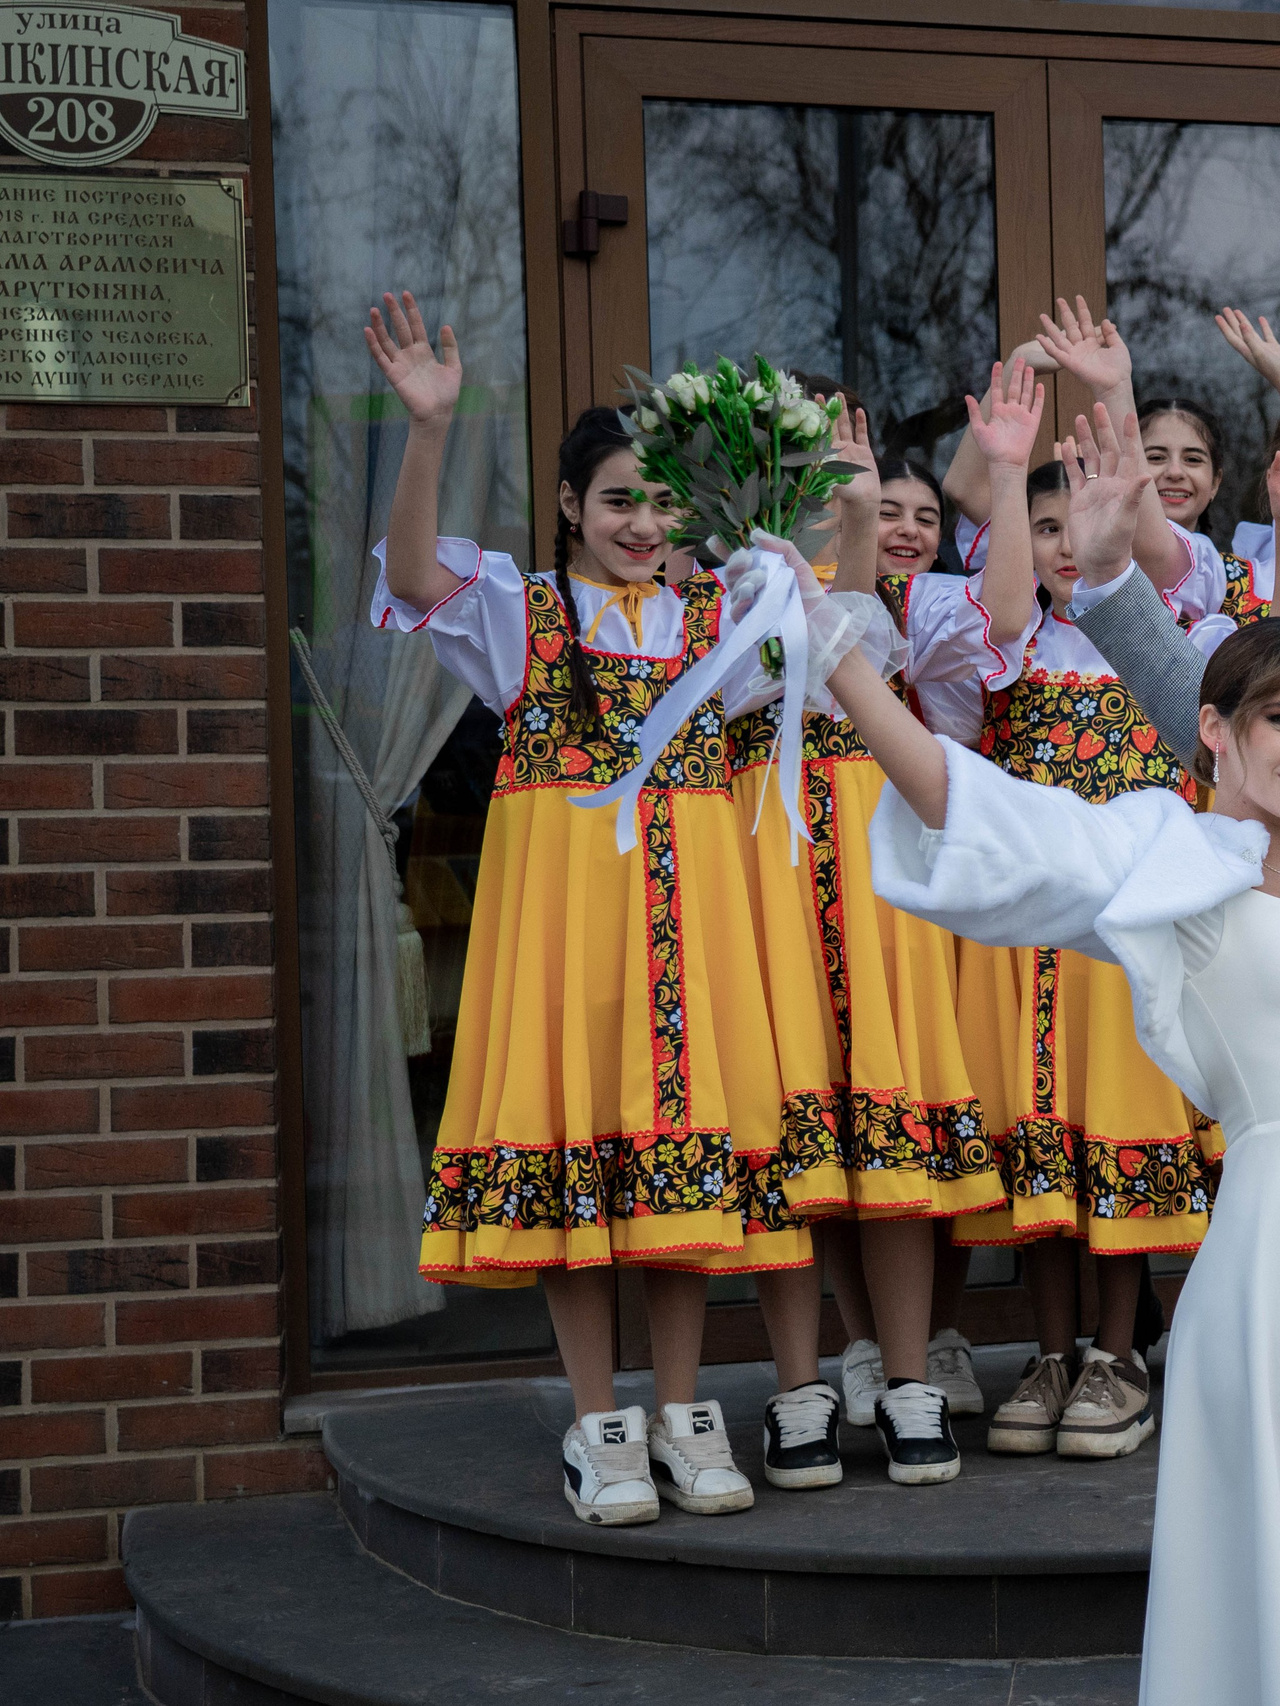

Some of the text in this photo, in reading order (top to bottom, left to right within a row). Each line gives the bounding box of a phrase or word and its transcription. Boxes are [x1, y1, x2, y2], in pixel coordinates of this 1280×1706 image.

[16, 13, 122, 37] улица
[27, 97, 117, 144] 208
[64, 189, 186, 207] ПОСТРОЕНО
[53, 211, 80, 225] НА
[88, 212, 195, 229] СРЕДСТВА
[59, 255, 225, 276] АРАМОВИЧА
[102, 330, 214, 348] ЧЕЛОВЕКА,
[54, 350, 188, 369] ОТДАЮЩЕГО
[31, 371, 92, 389] ДУШУ
[101, 372, 113, 386] И
[122, 372, 205, 390] СЕРДЦЕ
